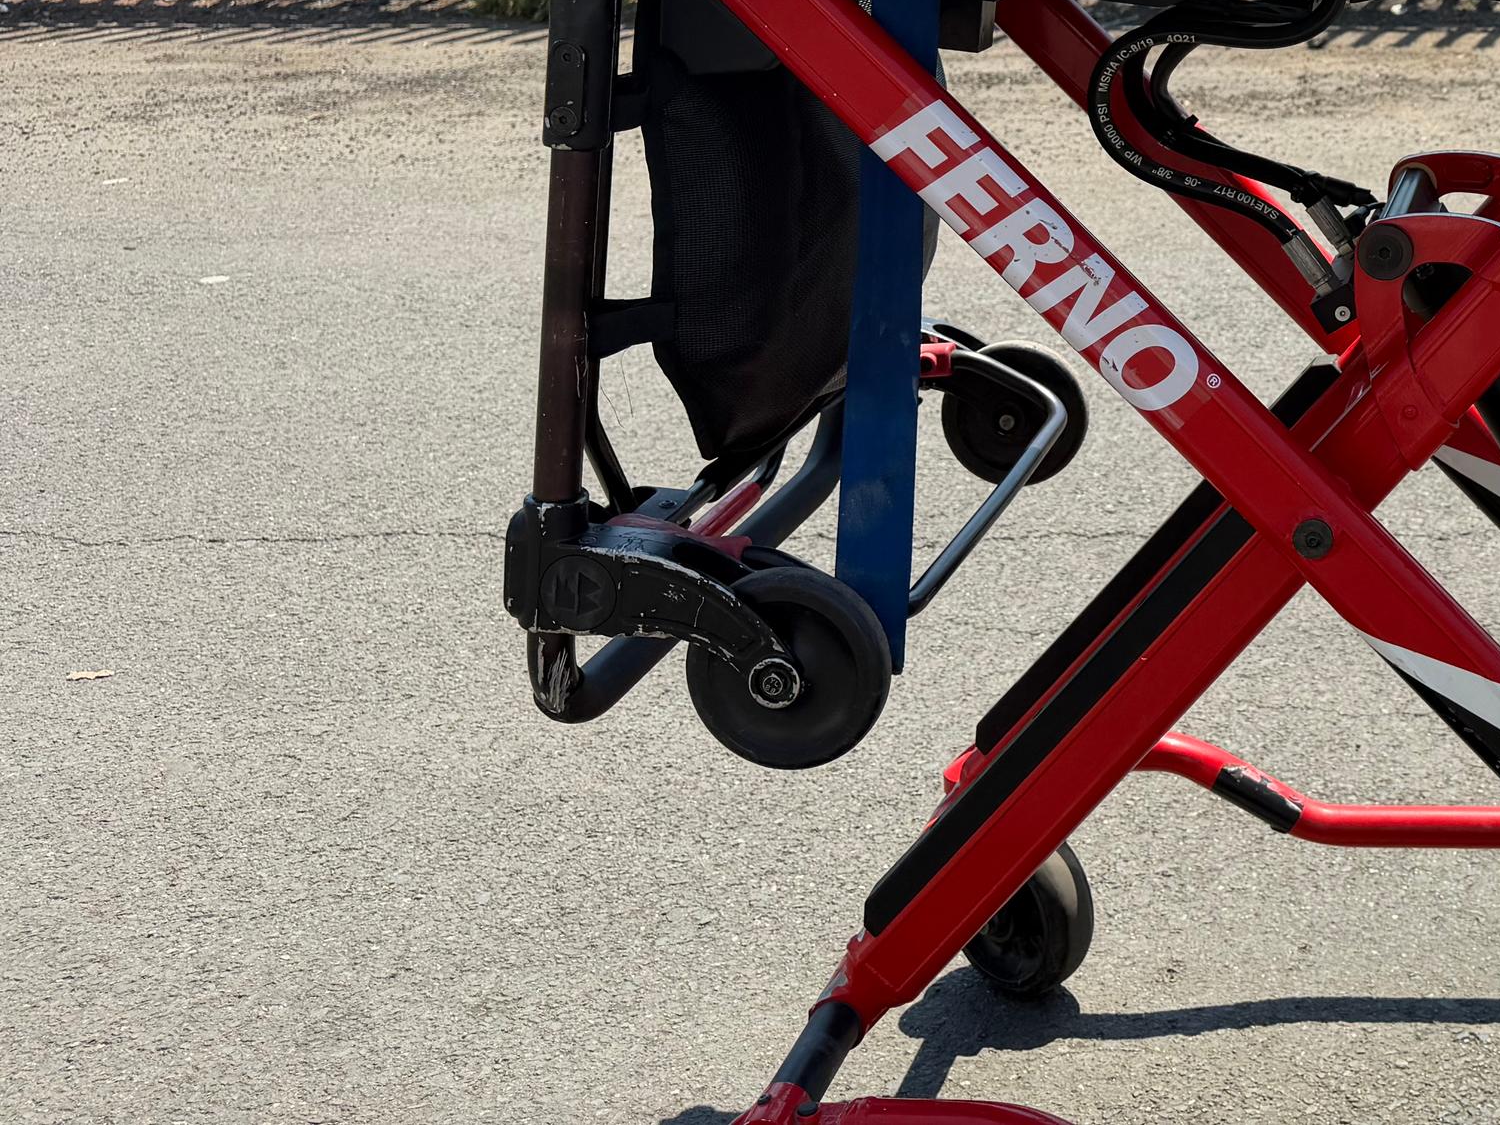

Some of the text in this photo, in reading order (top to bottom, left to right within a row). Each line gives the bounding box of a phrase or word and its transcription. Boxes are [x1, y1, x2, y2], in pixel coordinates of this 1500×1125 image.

[1167, 34, 1196, 43] 4Q21
[1116, 38, 1154, 62] IC-8/19
[1098, 61, 1120, 92] MSHA
[1097, 103, 1110, 123] PSI
[1104, 124, 1125, 149] 3000
[1124, 150, 1144, 166] WP
[1184, 176, 1202, 187] -06
[1213, 185, 1236, 198] R17
[1237, 192, 1280, 220] SAE100
[869, 99, 1199, 411] FERNO
